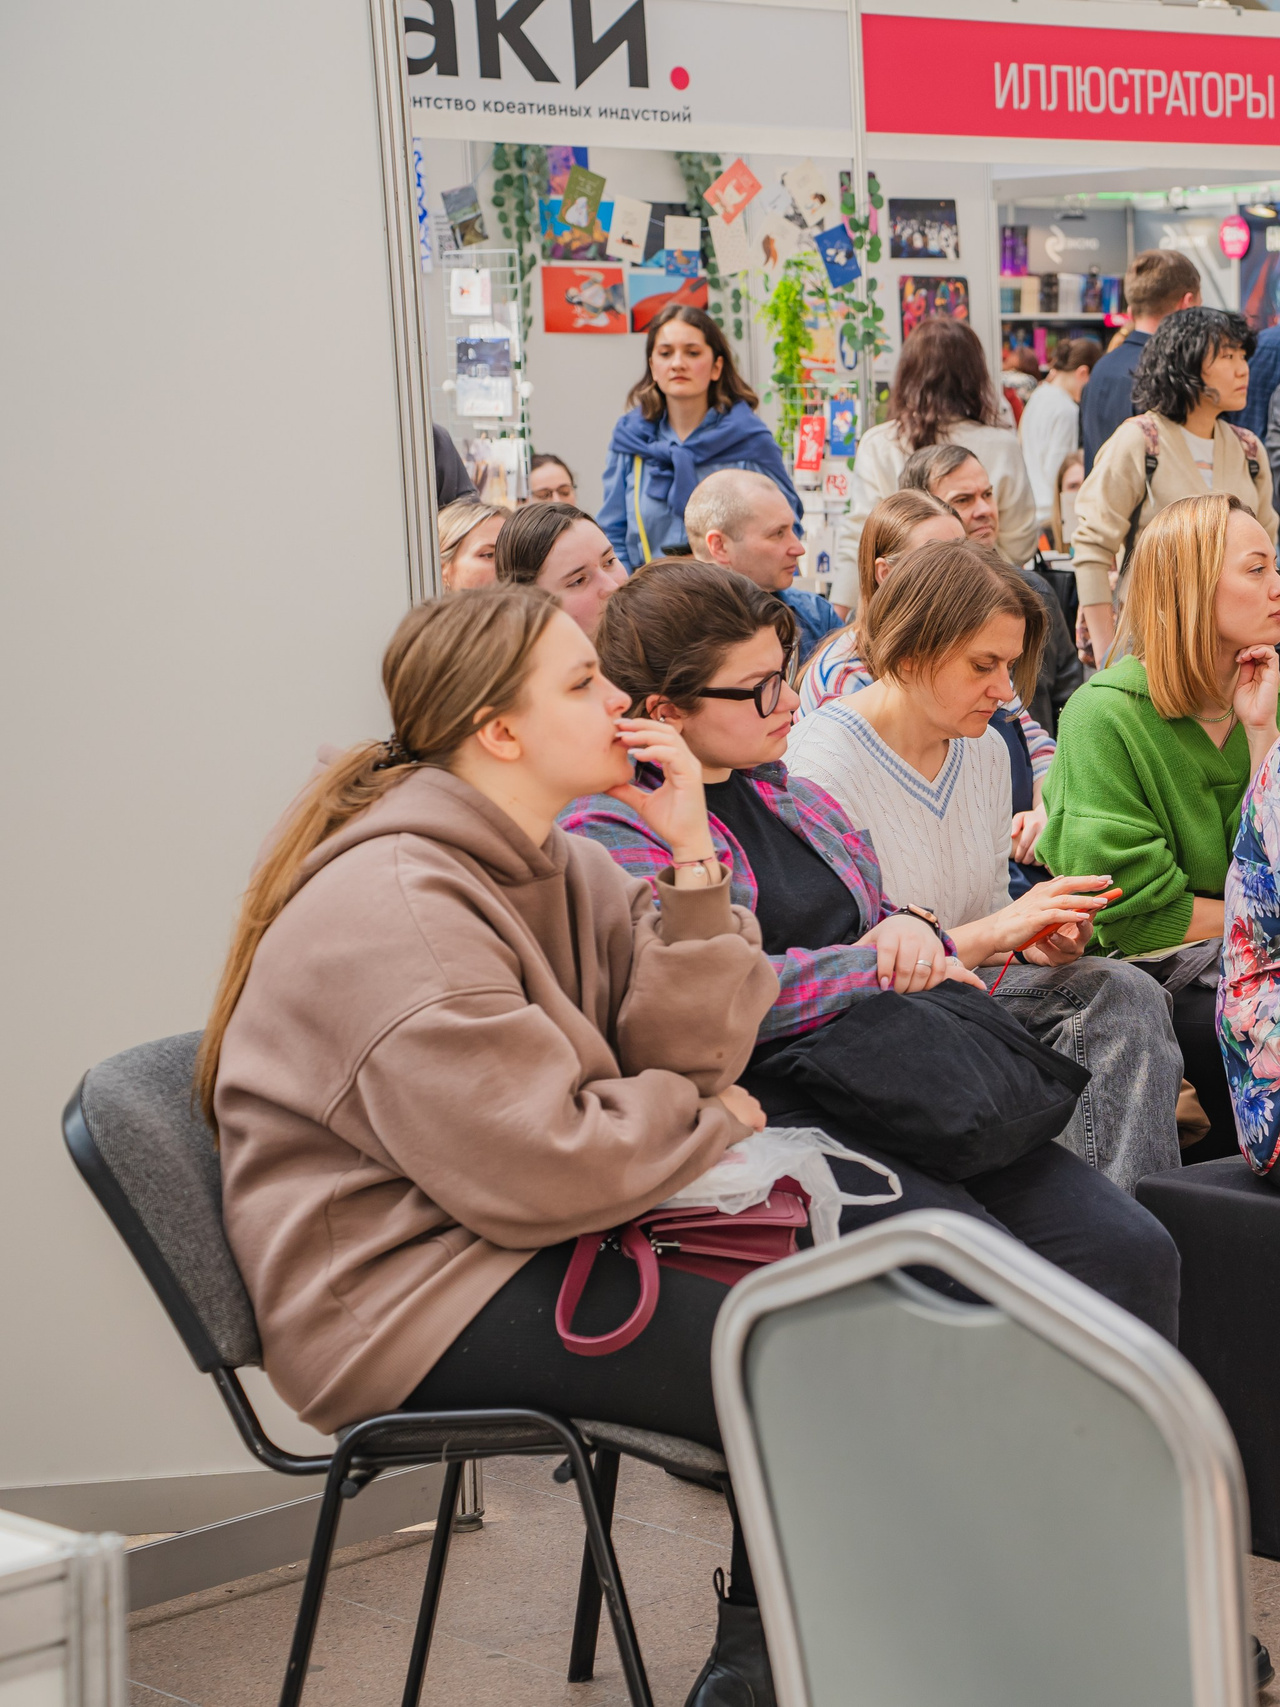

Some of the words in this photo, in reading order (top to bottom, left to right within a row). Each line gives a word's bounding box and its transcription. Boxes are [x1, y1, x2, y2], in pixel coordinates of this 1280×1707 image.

[409, 95, 476, 111] нтство
[483, 99, 592, 118] креативных
[994, 61, 1275, 119] ИЛЛЮСТРАТОРЫ
